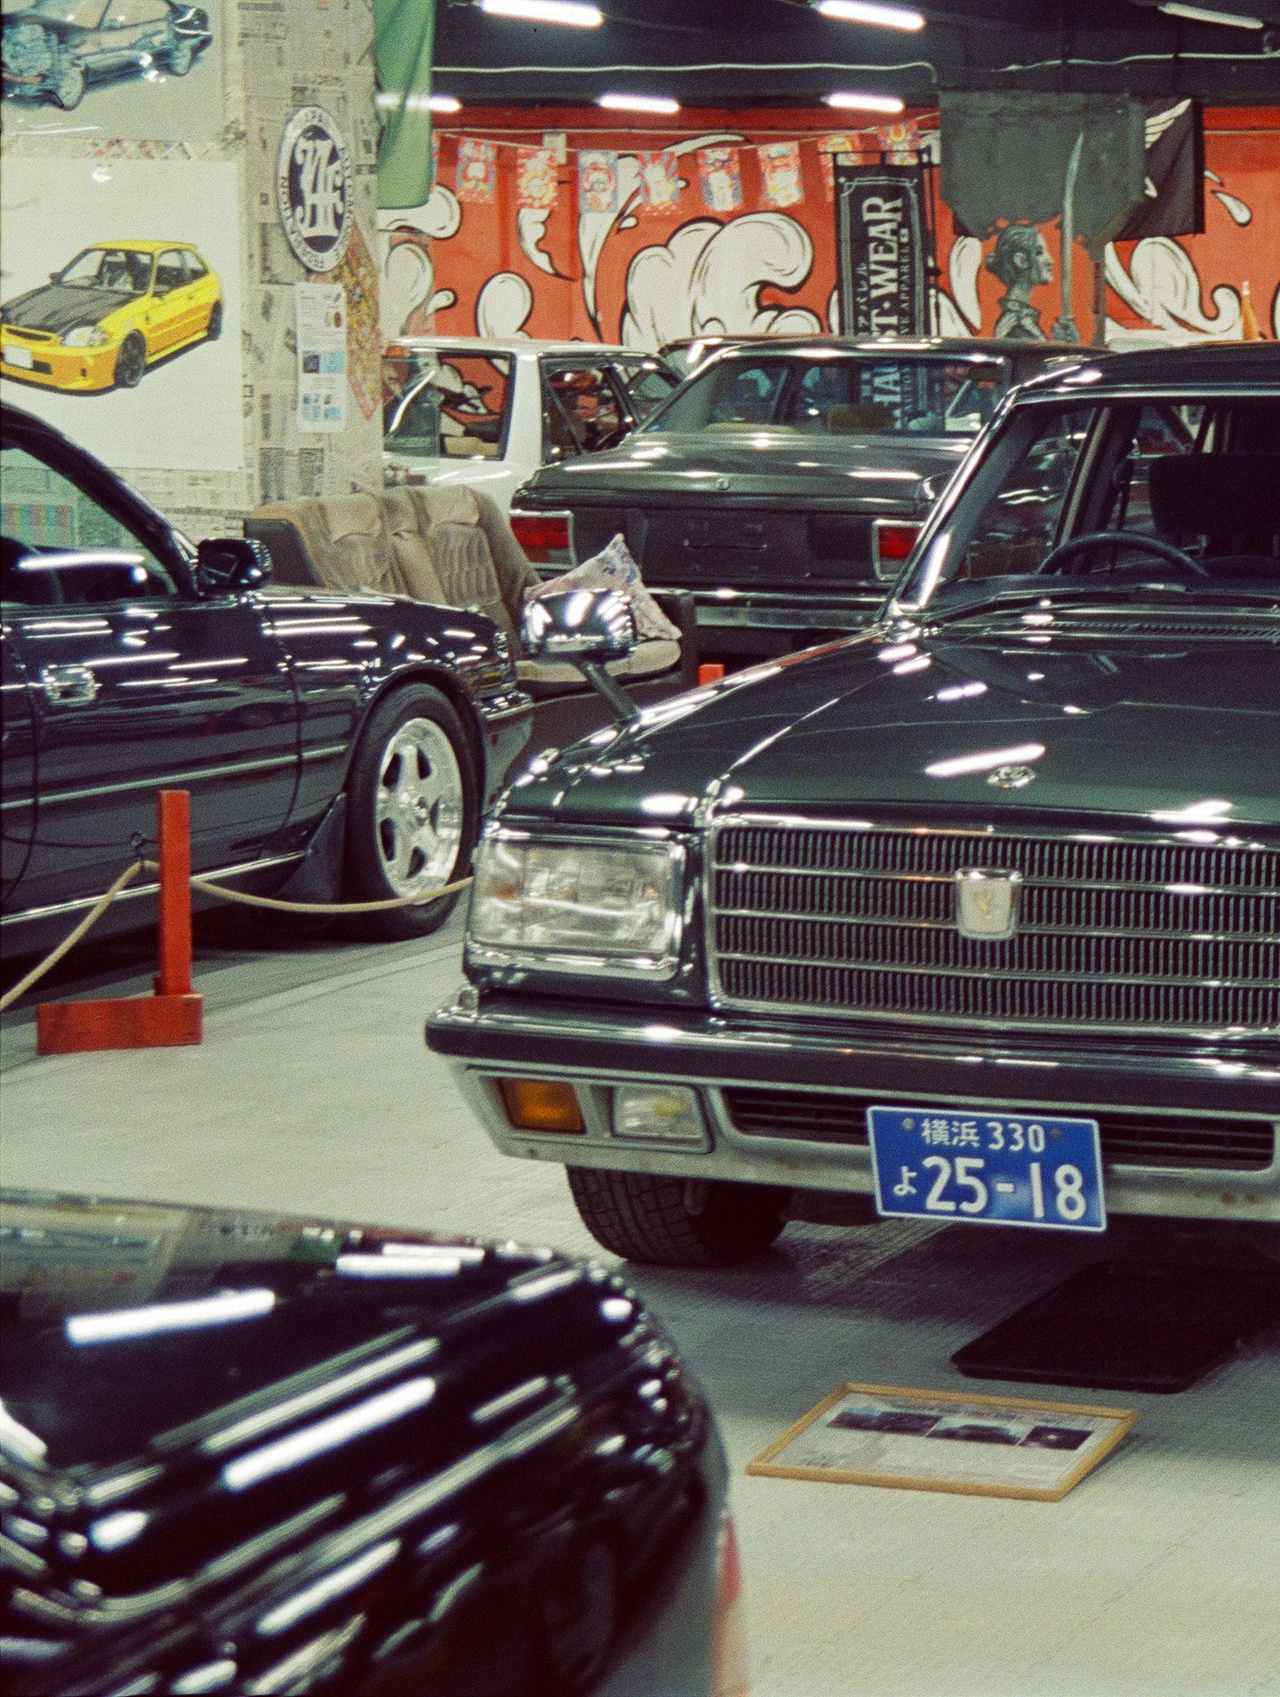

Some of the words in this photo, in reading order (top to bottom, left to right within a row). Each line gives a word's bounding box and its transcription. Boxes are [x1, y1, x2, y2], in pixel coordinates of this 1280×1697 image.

[921, 1118, 980, 1148] 横浜
[987, 1121, 1045, 1153] 330
[893, 1165, 917, 1196] よ
[922, 1156, 1086, 1221] 25-18
